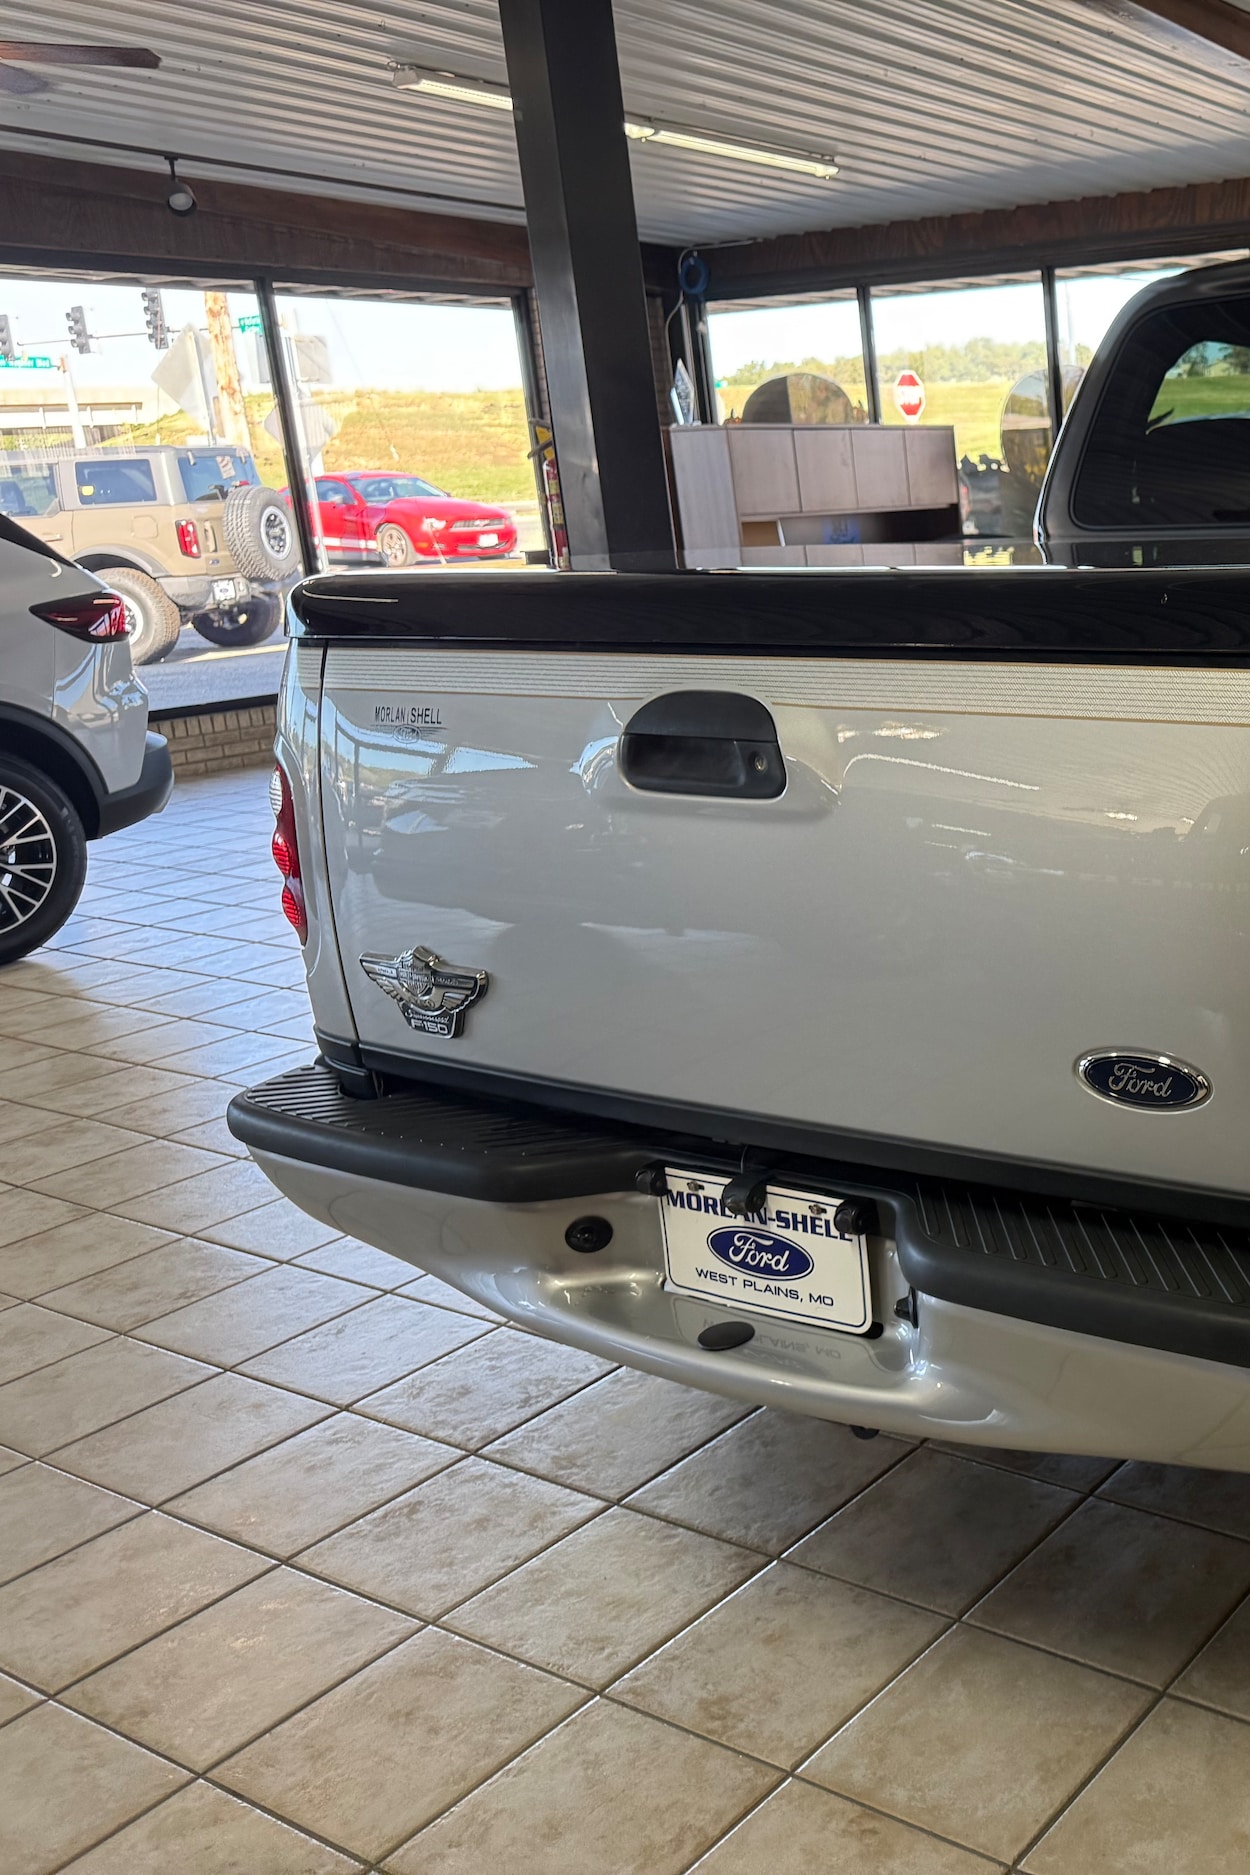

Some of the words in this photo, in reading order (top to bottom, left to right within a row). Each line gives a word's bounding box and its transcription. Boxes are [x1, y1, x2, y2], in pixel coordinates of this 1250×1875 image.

[374, 705, 406, 723] MORLAN
[410, 707, 442, 725] SHELL
[1108, 1062, 1173, 1098] Ford
[667, 1189, 853, 1243] MORLN-SHEL
[728, 1232, 790, 1273] Ford
[695, 1267, 738, 1287] WEST
[743, 1278, 804, 1303] PLAINS,
[808, 1292, 834, 1307] MO
